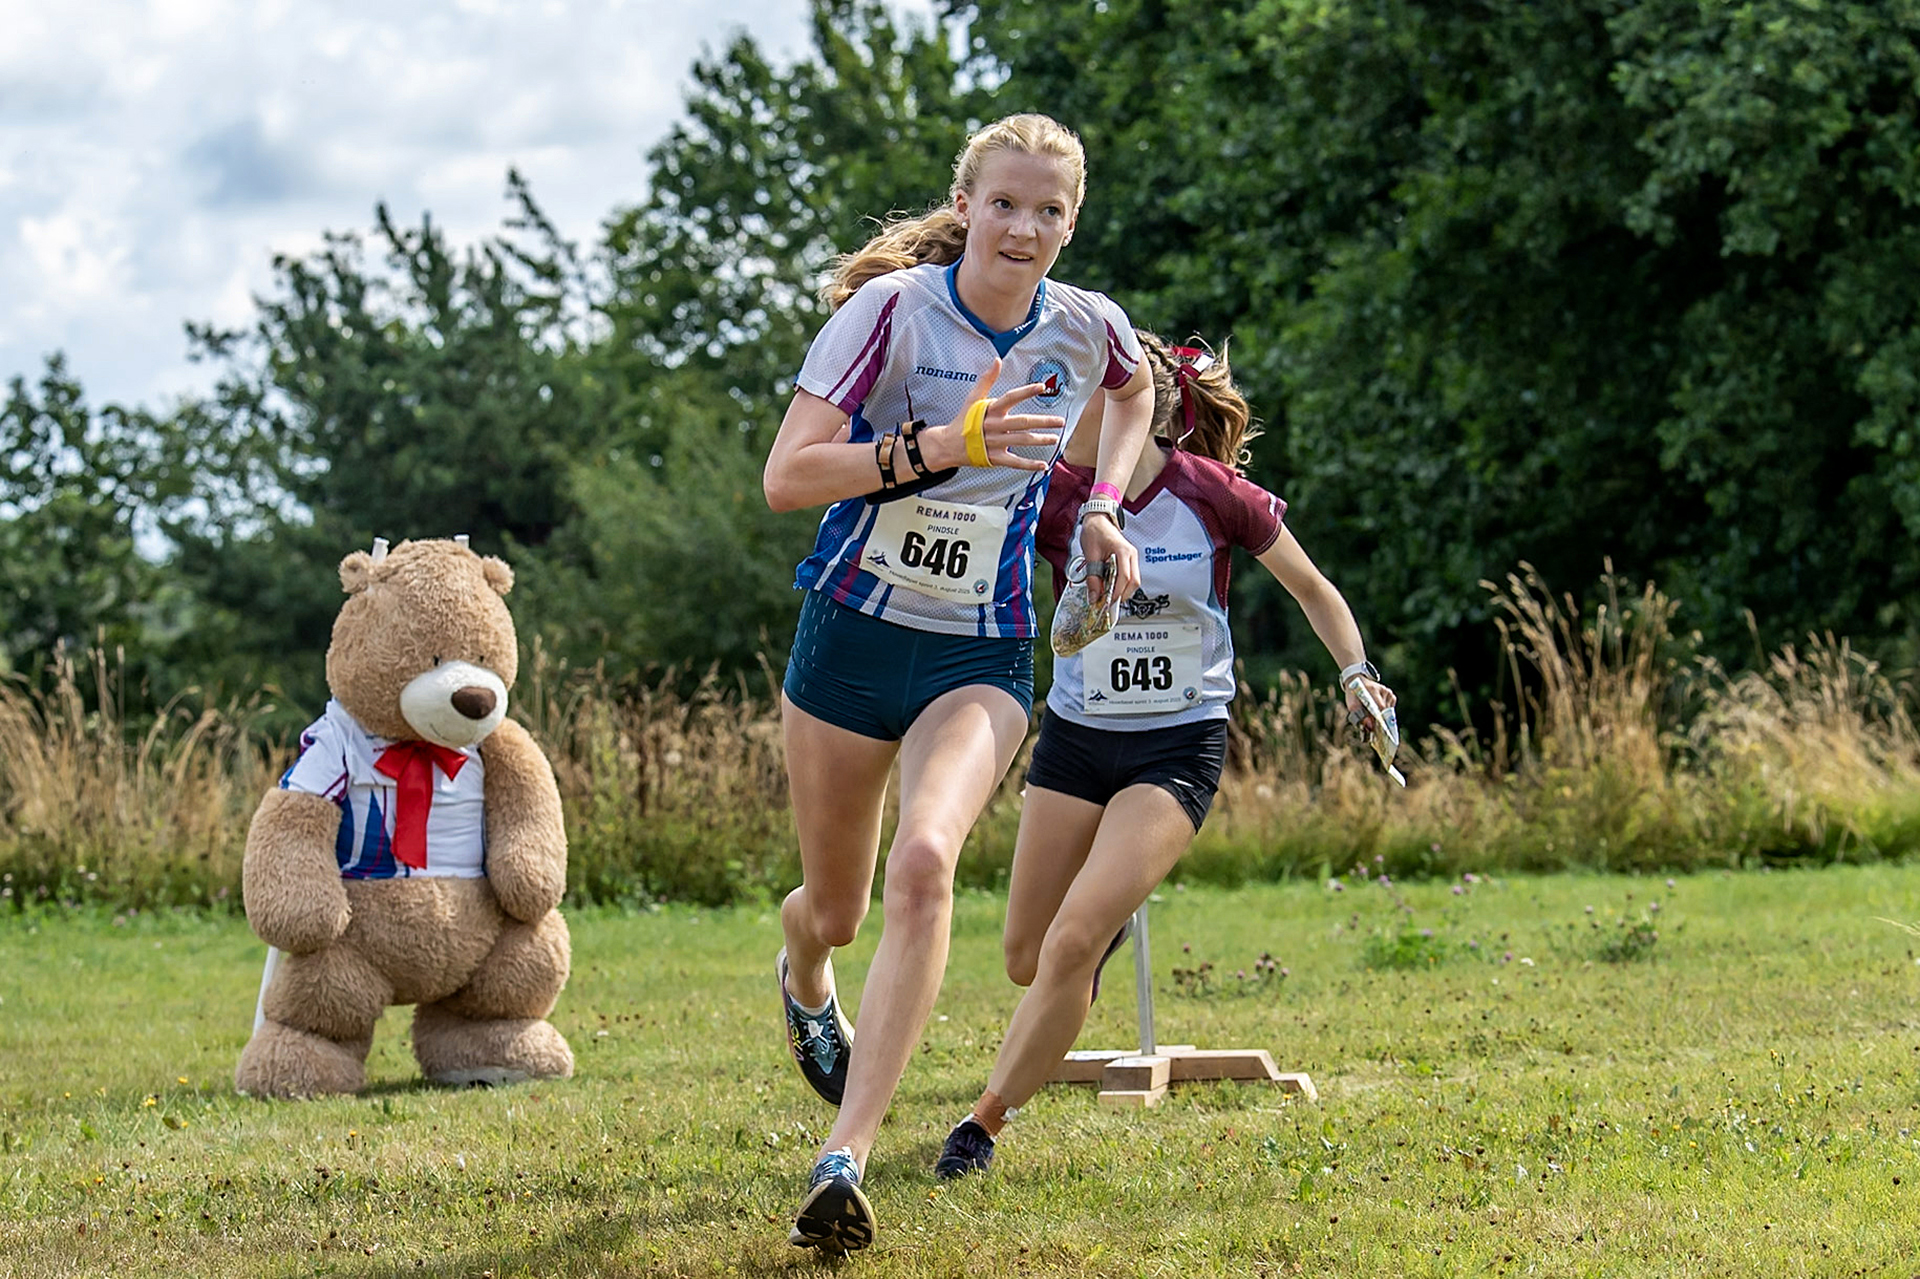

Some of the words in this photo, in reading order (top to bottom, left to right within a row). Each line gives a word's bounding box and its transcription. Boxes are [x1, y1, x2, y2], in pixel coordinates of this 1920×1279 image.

[915, 364, 978, 383] noname
[916, 505, 950, 520] REMA
[952, 510, 977, 523] 1000
[927, 524, 960, 536] PINDSLE
[900, 531, 971, 579] 646
[1144, 546, 1166, 555] Oslo
[1145, 551, 1203, 564] Sportslager
[1114, 631, 1143, 641] REMA
[1145, 631, 1169, 640] 1000
[1126, 645, 1156, 654] PINDSLE
[1110, 656, 1173, 693] 643
